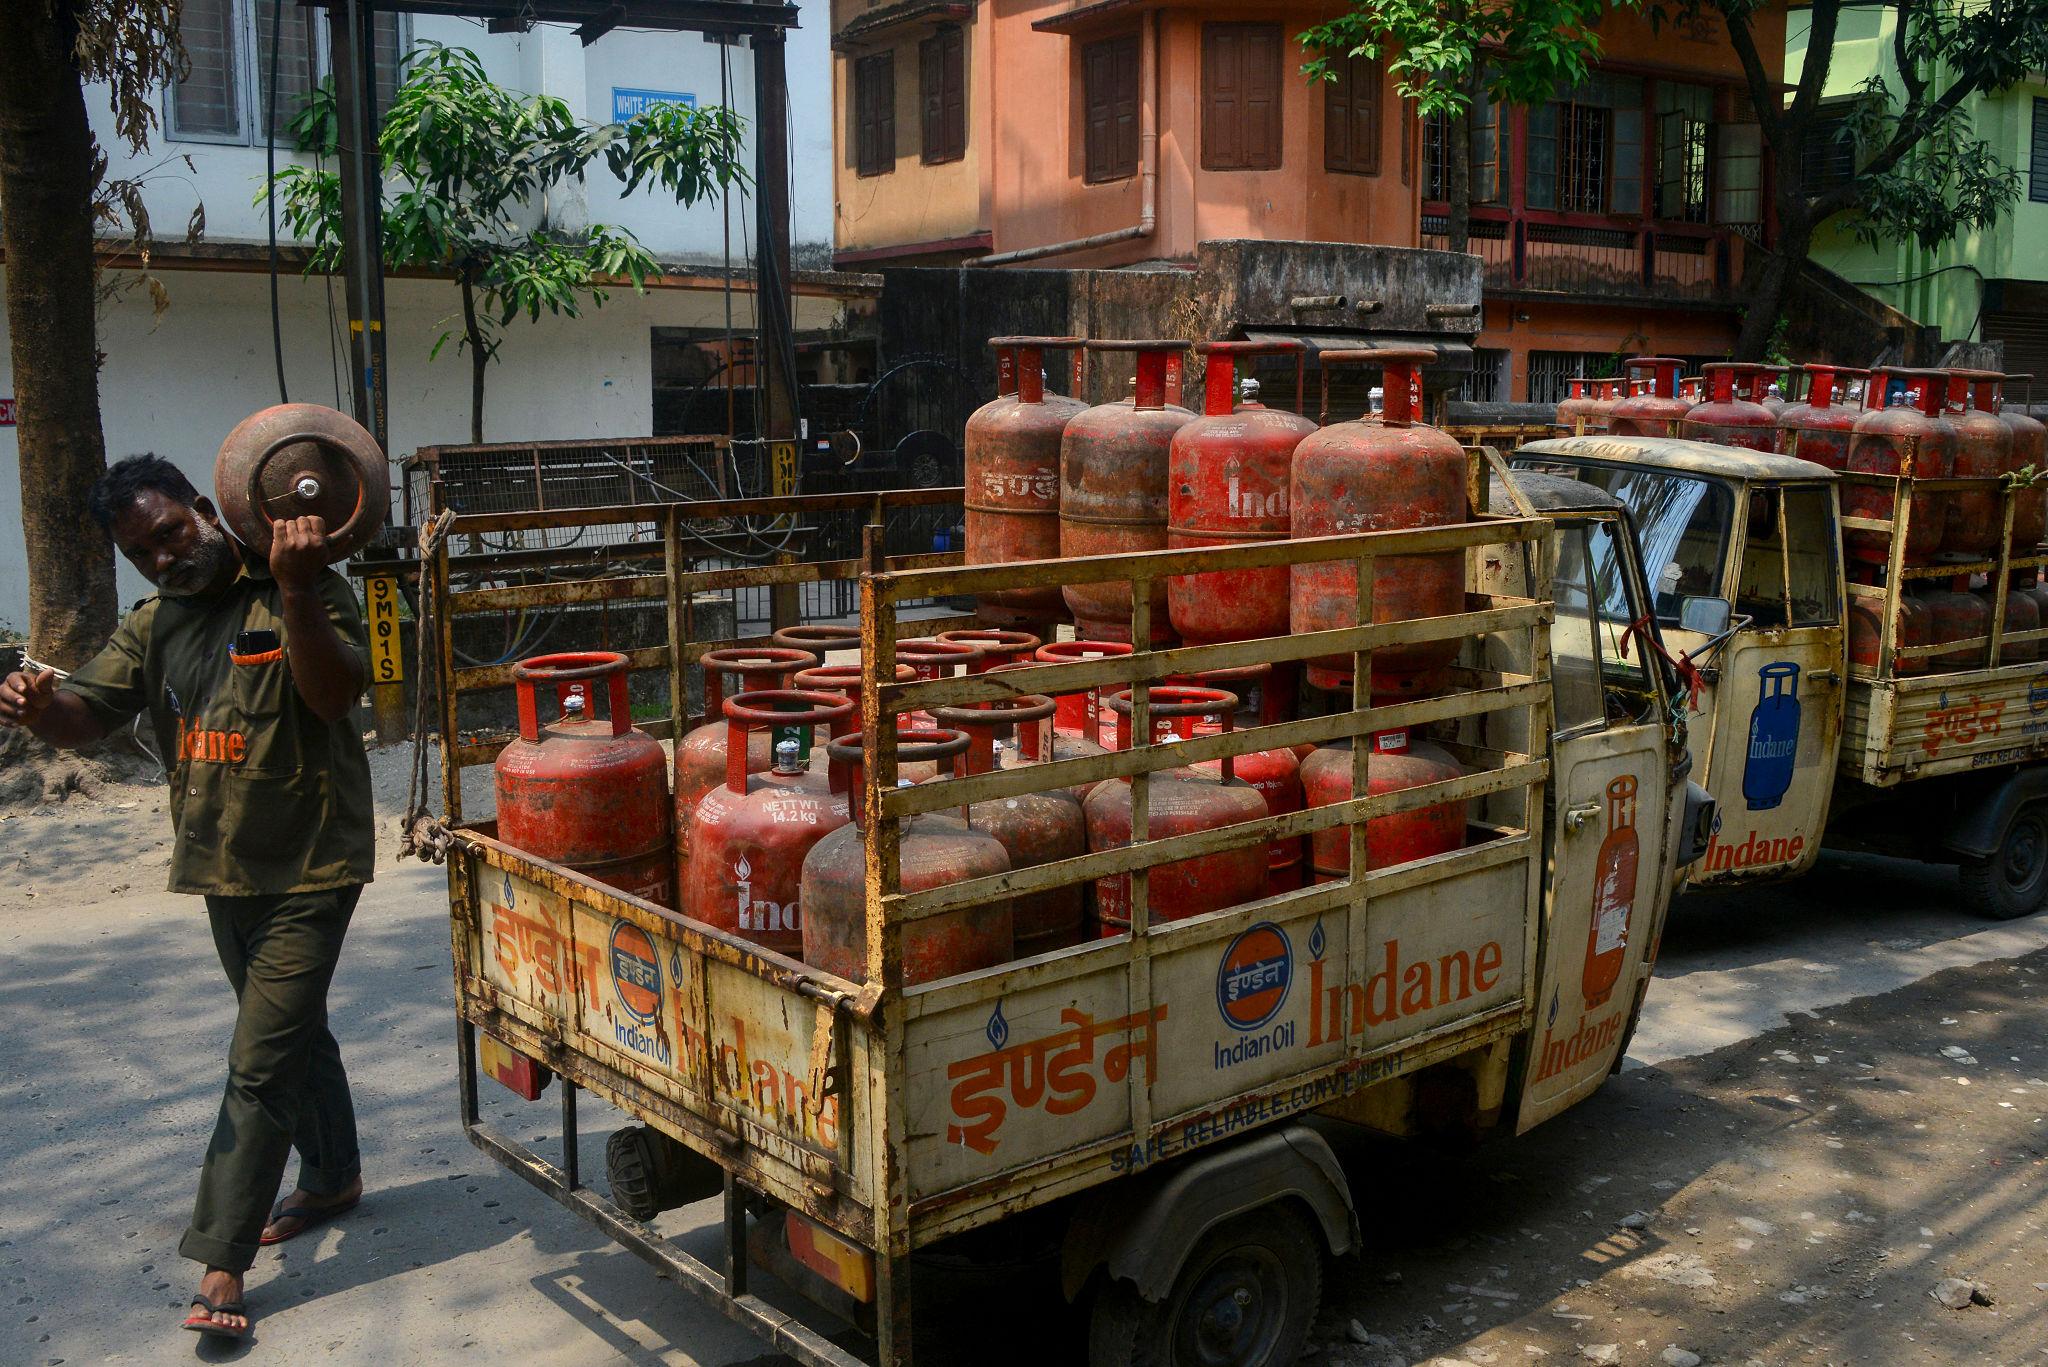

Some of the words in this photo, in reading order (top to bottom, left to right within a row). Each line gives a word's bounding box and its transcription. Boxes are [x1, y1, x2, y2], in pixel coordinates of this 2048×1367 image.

[616, 95, 643, 115] WHITE
[1750, 734, 1795, 759] Indane
[762, 800, 796, 813] NETT
[799, 800, 823, 811] WT.
[771, 810, 798, 824] 14.2
[800, 810, 817, 825] kg
[1703, 830, 1805, 873] Indane
[1306, 939, 1503, 1049] Indane
[1535, 1010, 1623, 1085] Indane
[947, 1002, 1169, 1156] इण्डेन
